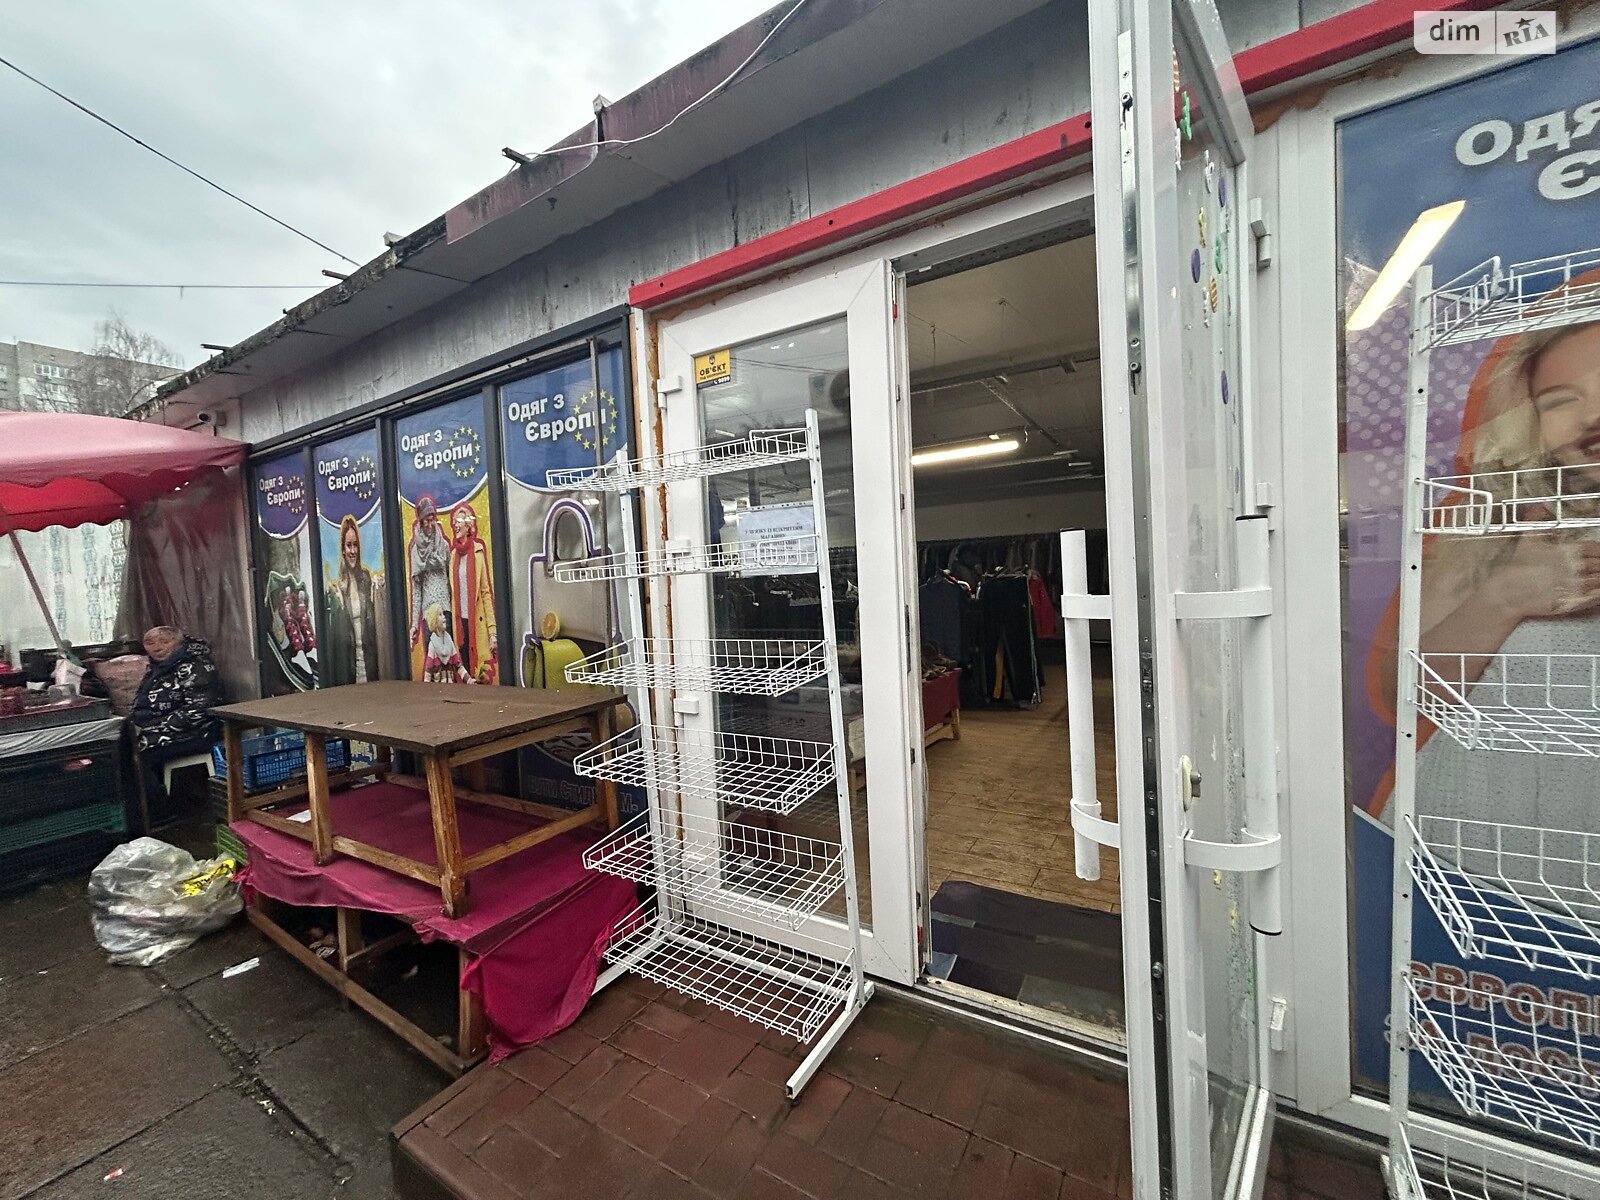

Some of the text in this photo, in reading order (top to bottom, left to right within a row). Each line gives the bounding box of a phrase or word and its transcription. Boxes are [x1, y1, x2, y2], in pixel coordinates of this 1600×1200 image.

[508, 398, 548, 423] Одяг
[401, 433, 430, 453] Одяг
[414, 443, 473, 470] Європи
[318, 460, 340, 476] Одяг
[259, 478, 277, 492] Одяг
[328, 469, 371, 491] Європи
[267, 488, 301, 506] Європи
